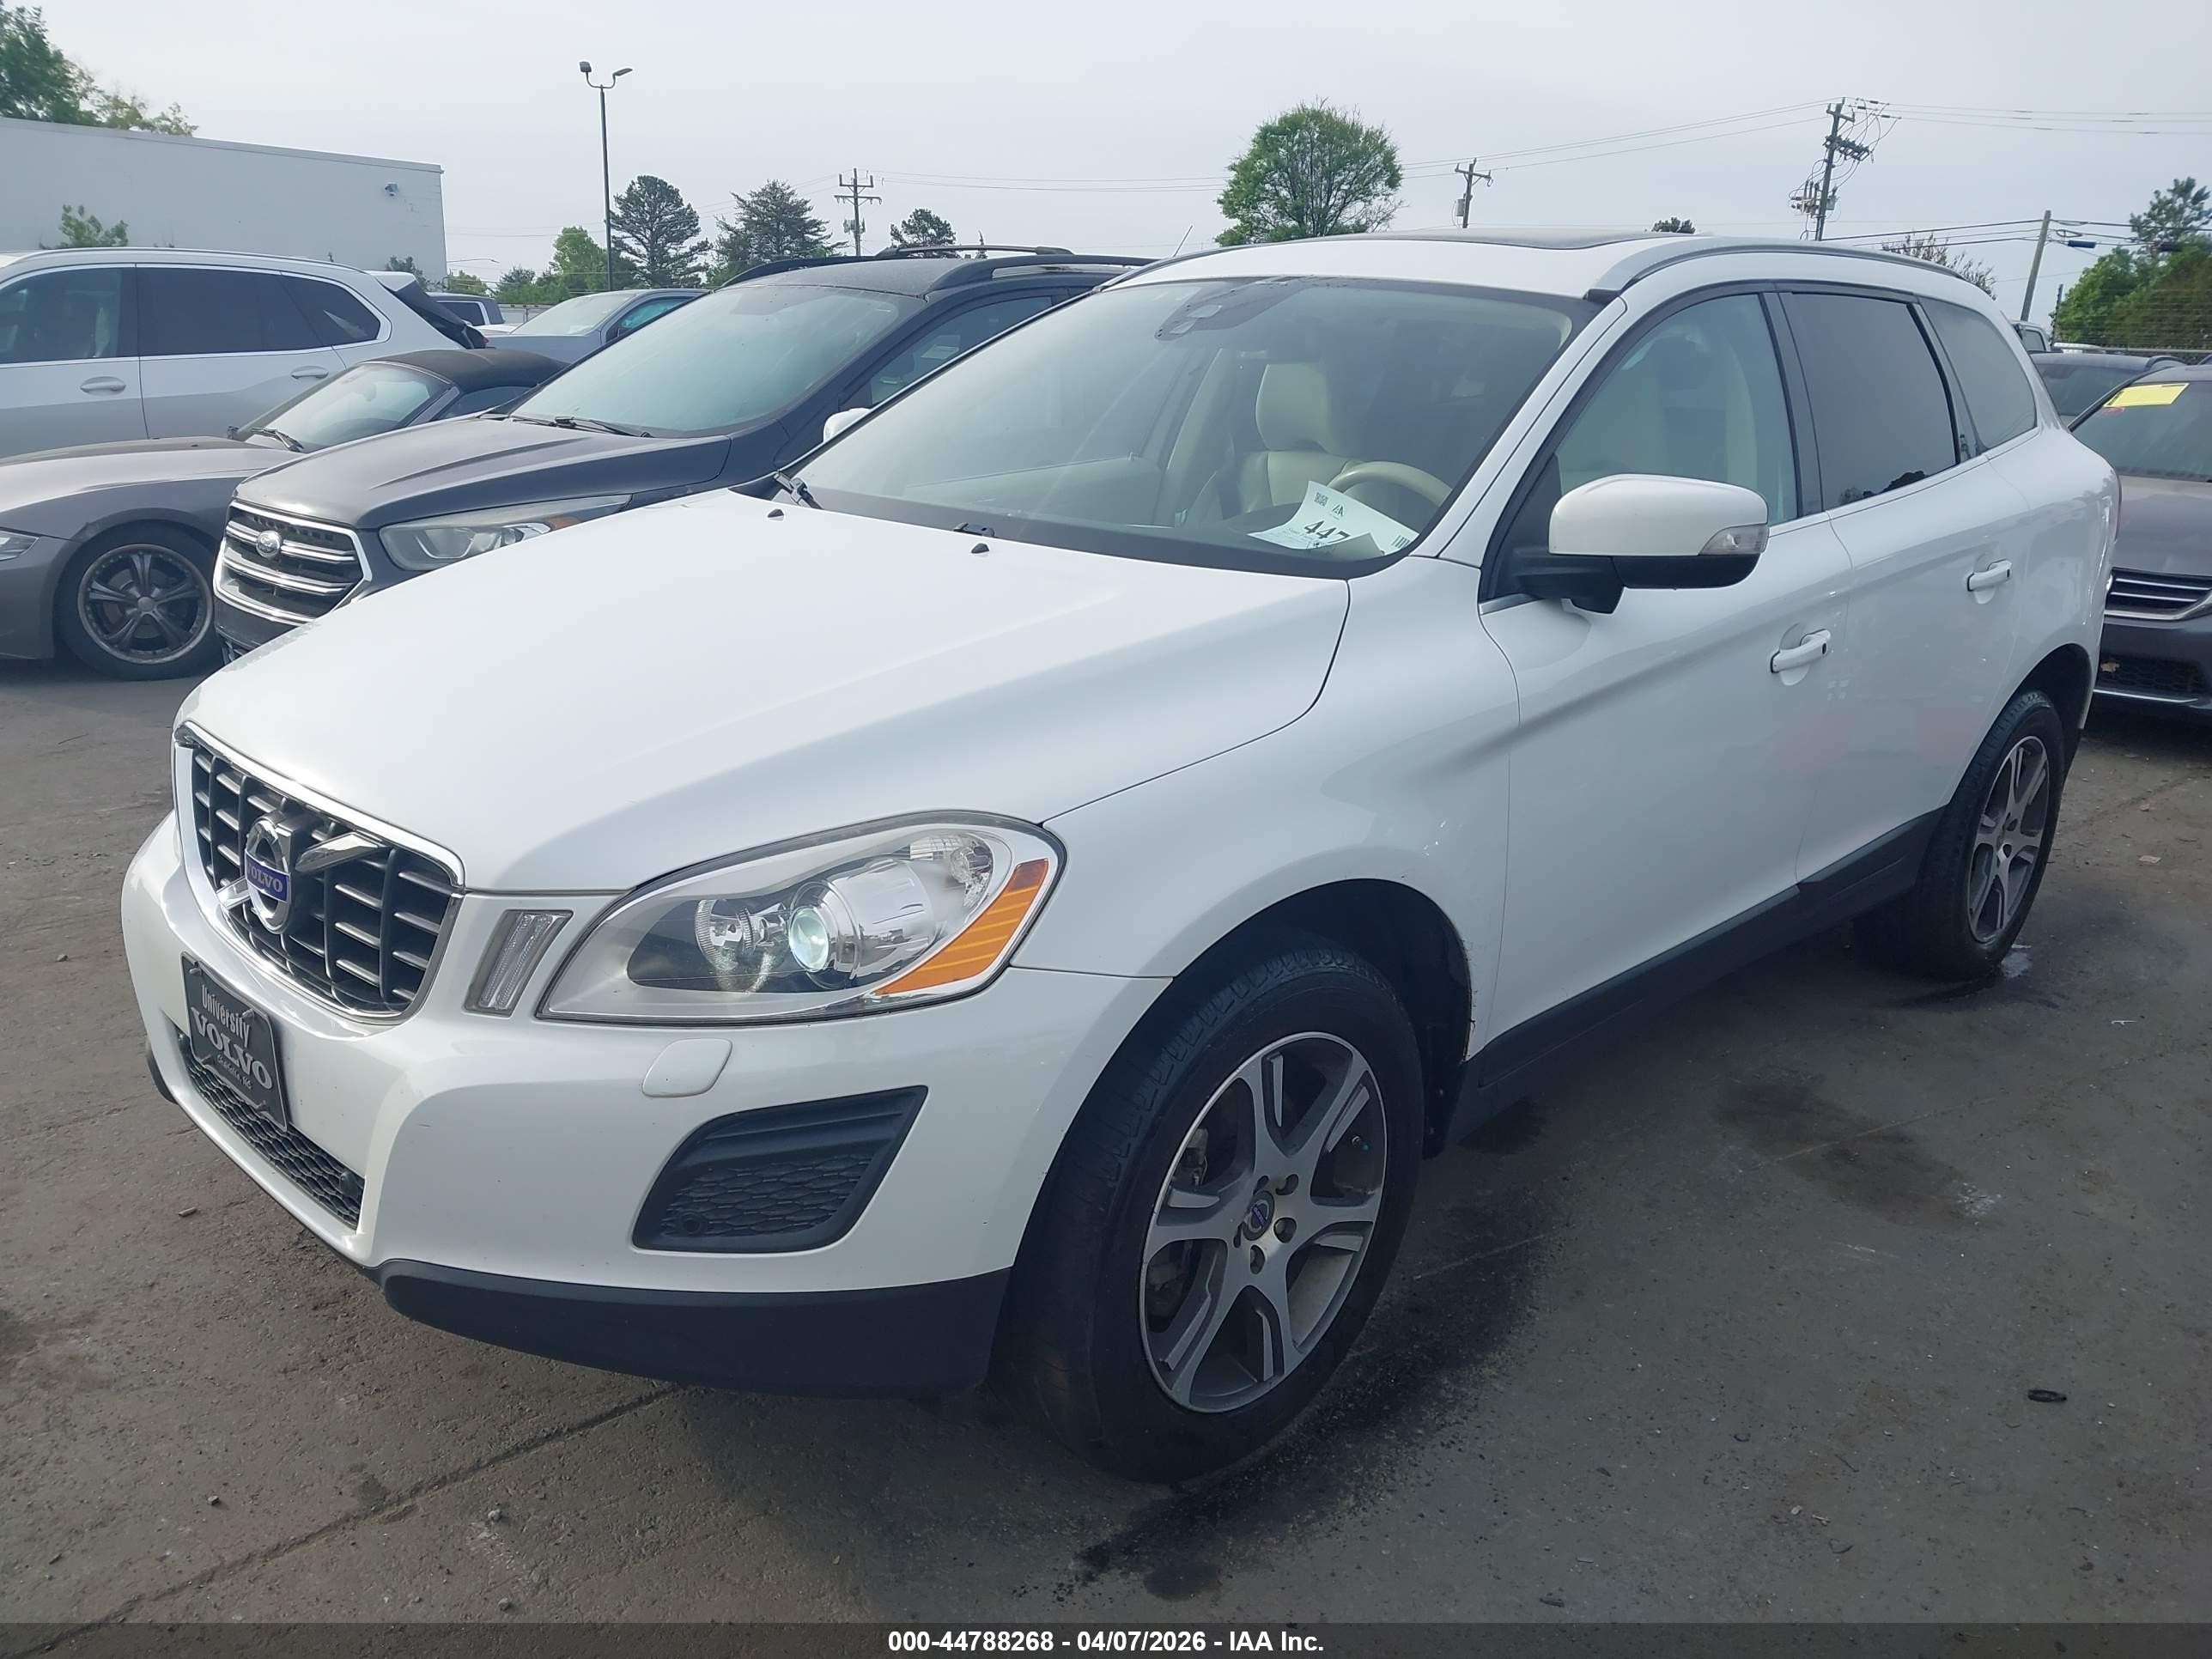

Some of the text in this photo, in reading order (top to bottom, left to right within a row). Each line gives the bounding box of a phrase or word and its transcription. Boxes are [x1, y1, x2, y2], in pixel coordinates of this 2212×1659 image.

[1304, 520, 1351, 544] 447
[246, 861, 283, 893] VOLVO
[201, 984, 251, 1048] University
[191, 1006, 273, 1090] VOLVO
